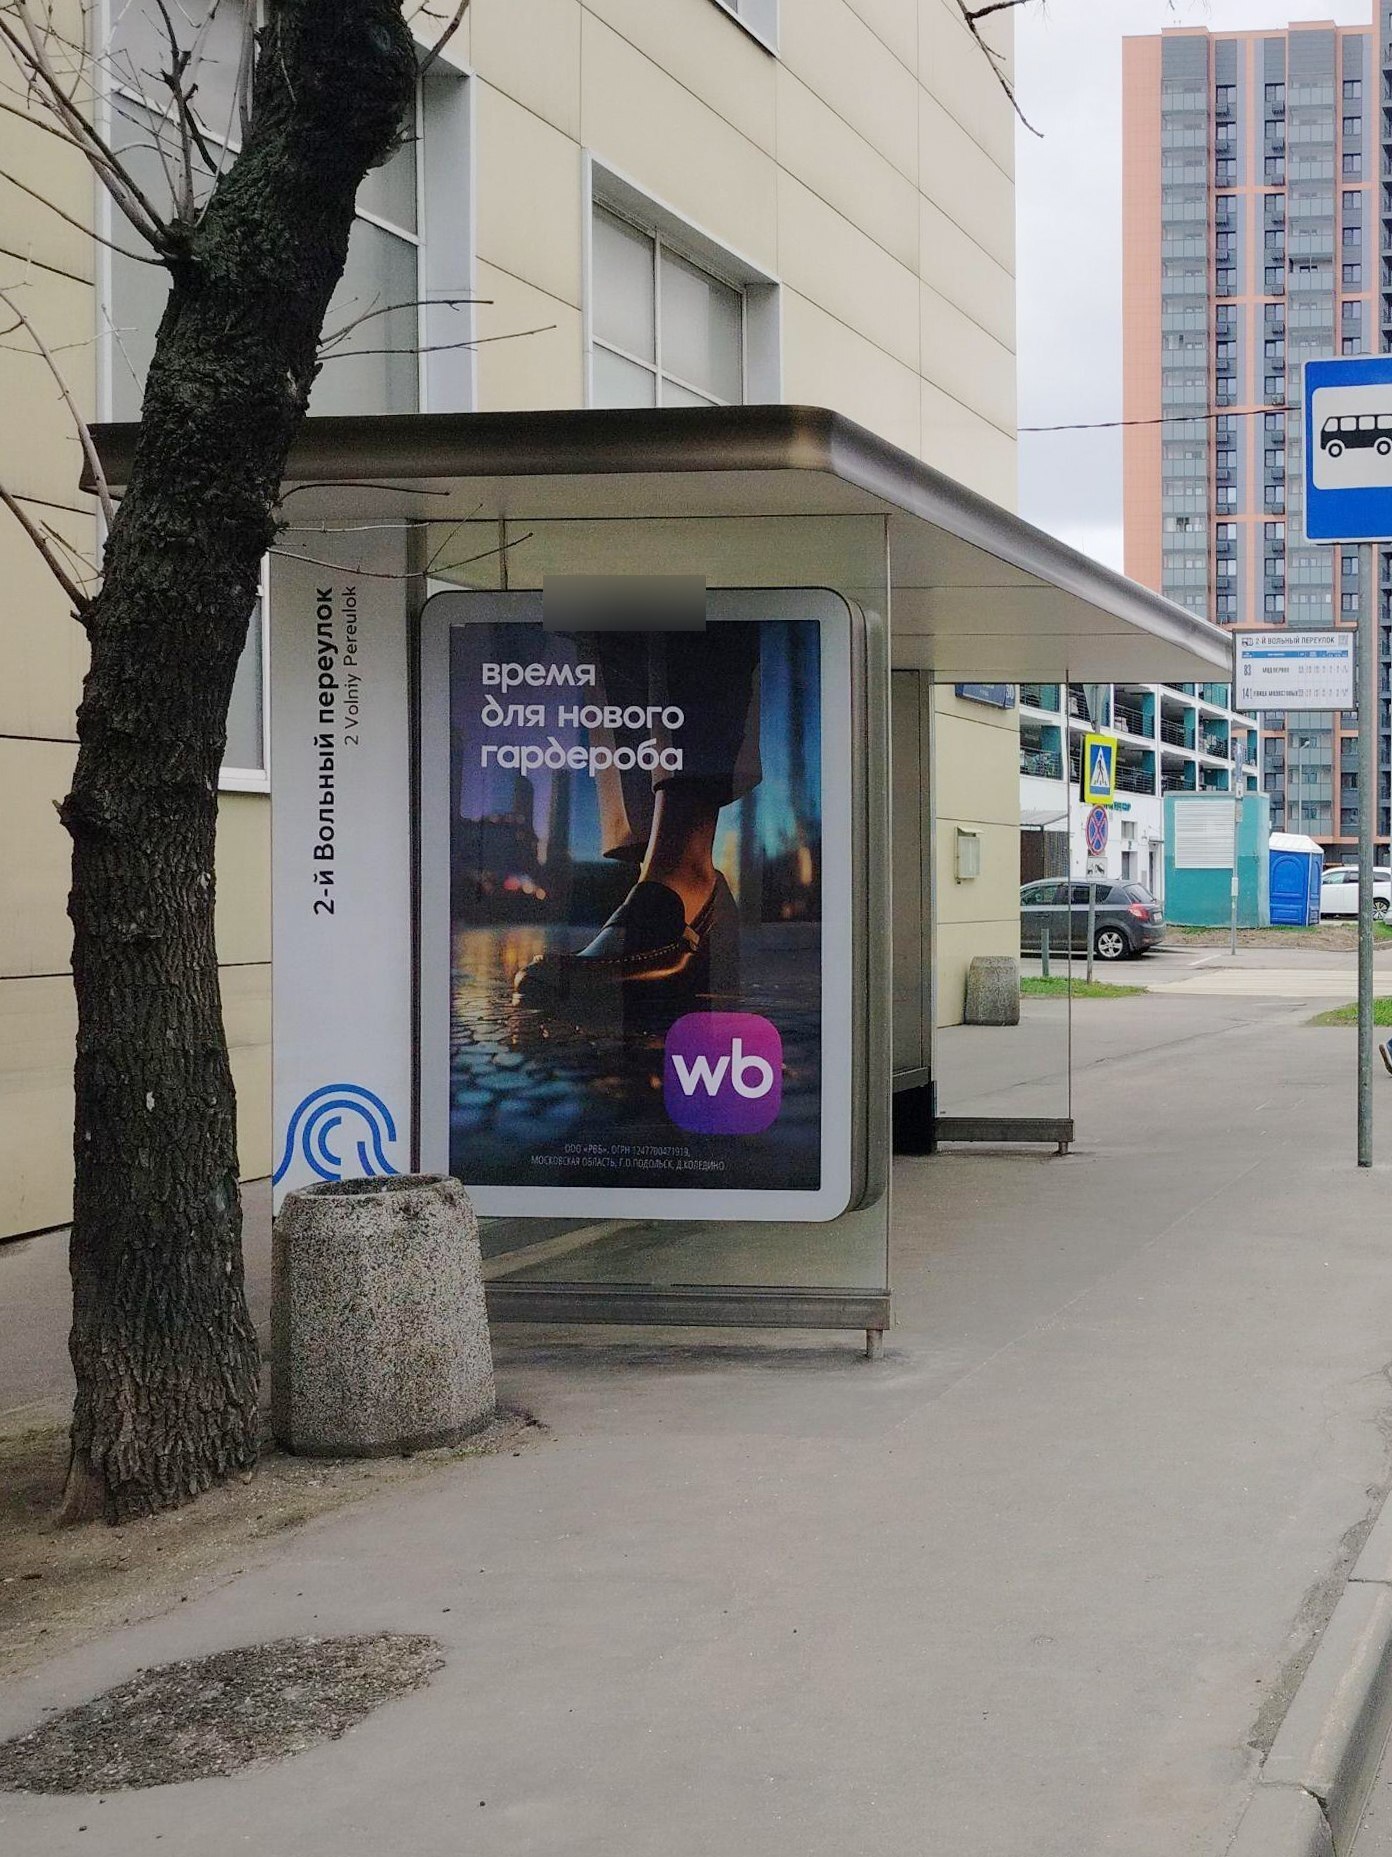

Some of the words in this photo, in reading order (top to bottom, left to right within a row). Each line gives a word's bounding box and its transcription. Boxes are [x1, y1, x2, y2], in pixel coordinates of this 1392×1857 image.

[341, 585, 359, 667] Pereulok
[1268, 636, 1300, 645] ВОЛЬНЫЙ
[1301, 636, 1335, 645] ПЕРЕУЛОК
[313, 587, 340, 724] переулок
[1243, 664, 1252, 676] 83
[481, 662, 596, 694] время
[343, 672, 362, 730] Volniy
[480, 694, 546, 728] для
[557, 704, 685, 730] нового
[343, 735, 359, 746] 2
[480, 736, 684, 778] гардероба
[312, 733, 335, 861] Вольный
[313, 869, 335, 917] 2-й
[672, 1037, 775, 1099] wb
[530, 1155, 580, 1166] МОСКОВСКАЯ
[564, 1144, 581, 1154] ООО
[611, 1144, 631, 1155] ОГРН
